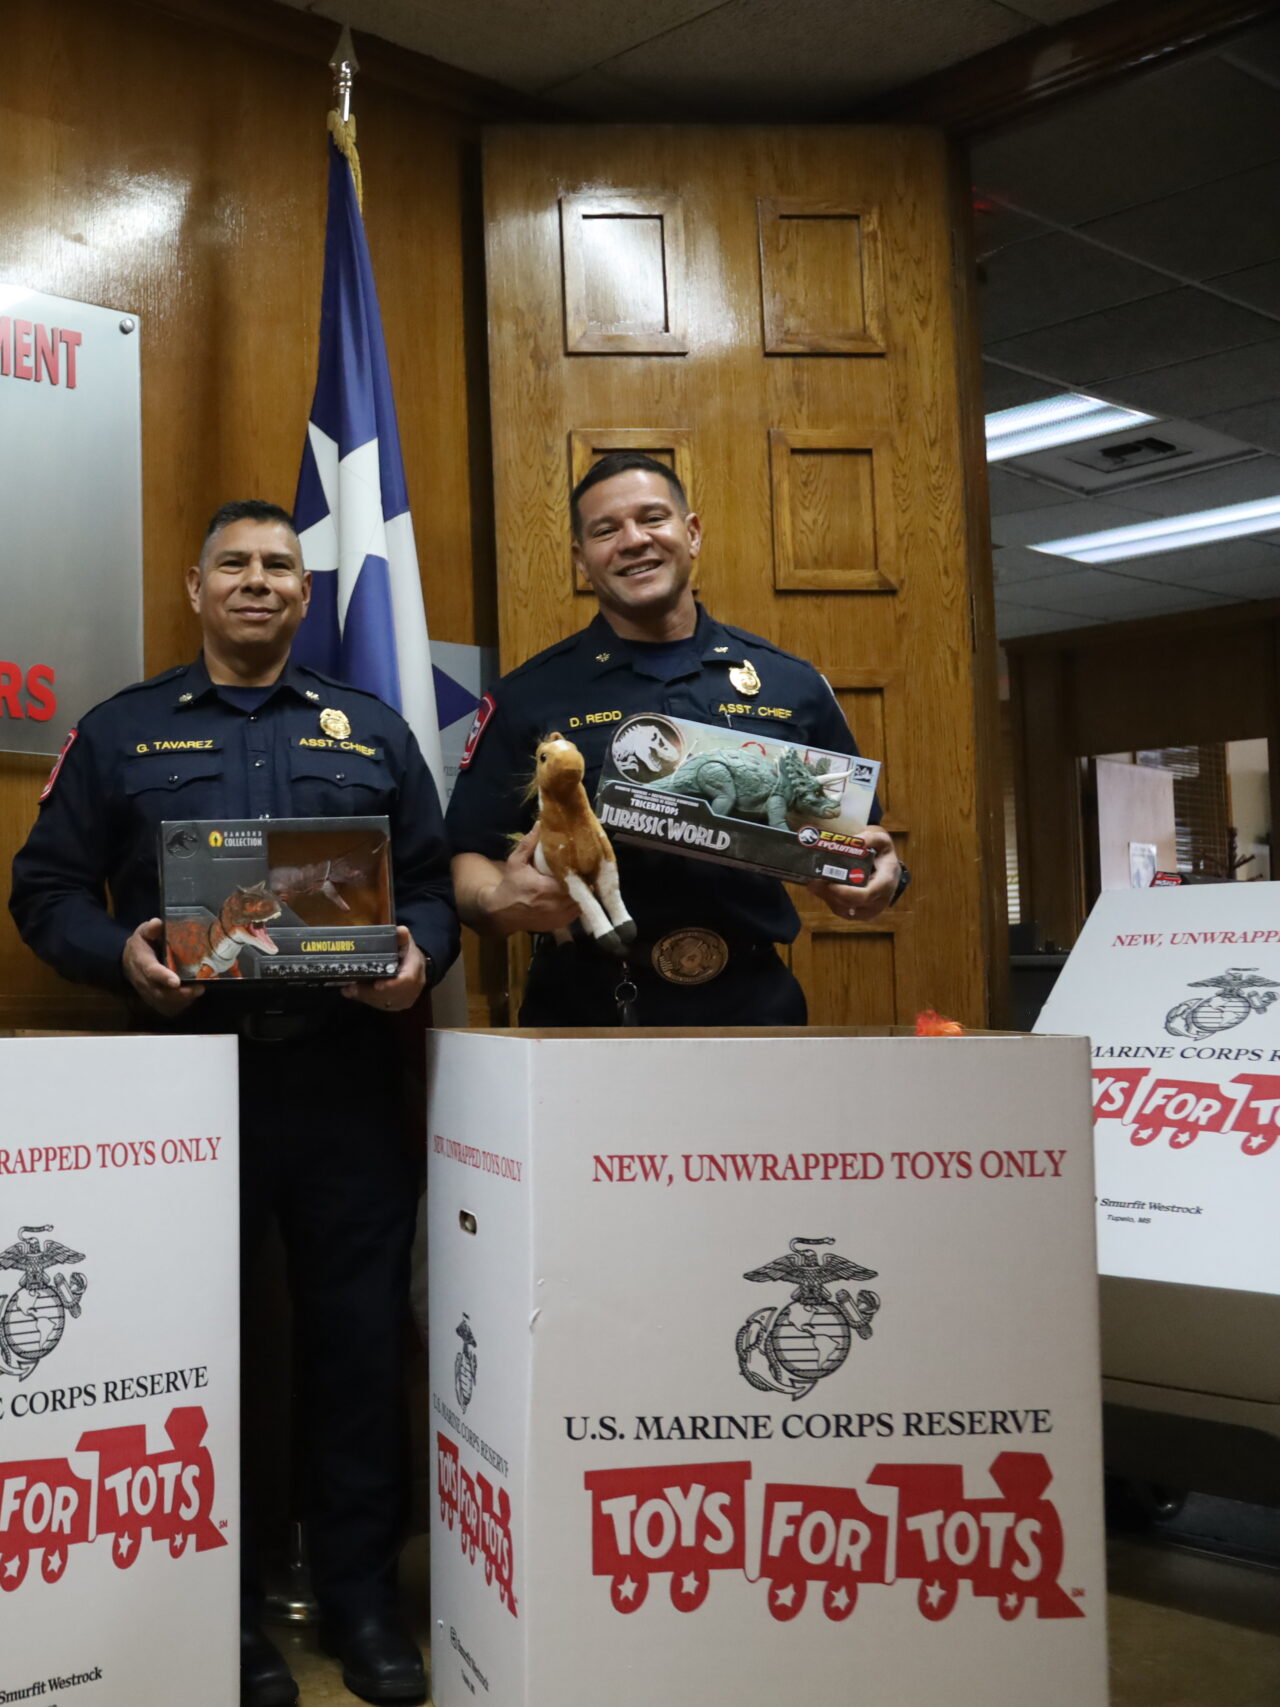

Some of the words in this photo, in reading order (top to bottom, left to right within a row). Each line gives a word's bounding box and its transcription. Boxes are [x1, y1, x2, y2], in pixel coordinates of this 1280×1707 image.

[569, 717, 583, 727] D.
[585, 710, 622, 724] REDD
[718, 703, 755, 715] ASST.
[758, 706, 792, 719] CHIEF
[136, 743, 149, 753] G.
[153, 739, 214, 751] TAVAREZ
[299, 737, 337, 748] ASST.
[340, 741, 376, 756] CHIEF
[630, 798, 679, 815] TRICERATOPS
[600, 803, 667, 837] JURASSIC
[667, 818, 731, 850] WORLD
[224, 838, 262, 846] COLLECTION
[818, 840, 865, 856] EVOLUTION
[820, 831, 866, 847] EPIC
[301, 940, 355, 952] CARNOTAURUS
[1112, 933, 1163, 947] NEW,
[1170, 930, 1280, 945] UNWRAPP
[1180, 1046, 1264, 1062] CORPS
[1092, 1077, 1130, 1112] YS
[1142, 1087, 1221, 1126] FOR
[96, 1140, 156, 1168] TOYS
[160, 1136, 222, 1164] ONLY
[592, 1153, 675, 1187] NEW,
[681, 1152, 884, 1182] UNWRAPPED
[891, 1150, 973, 1180] TOYS
[979, 1149, 1067, 1179] ONLY
[1100, 1198, 1146, 1210] Smurfit
[1149, 1202, 1204, 1215] Westrock
[10, 1383, 97, 1417] CORPS
[103, 1366, 209, 1403] RESERVE
[564, 1415, 626, 1441] U.S.
[633, 1415, 773, 1440] MARINE
[780, 1412, 895, 1439] CORPS
[902, 1409, 1053, 1437] RESERVE
[104, 1461, 201, 1521] TOTS
[438, 1451, 457, 1502] TOYS
[462, 1490, 477, 1535] FOR
[483, 1512, 510, 1579] TOTS
[601, 1482, 735, 1559] TOYS
[767, 1501, 871, 1571] FOR
[905, 1509, 1042, 1581] TOTS
[48, 1666, 103, 1692] Westrock
